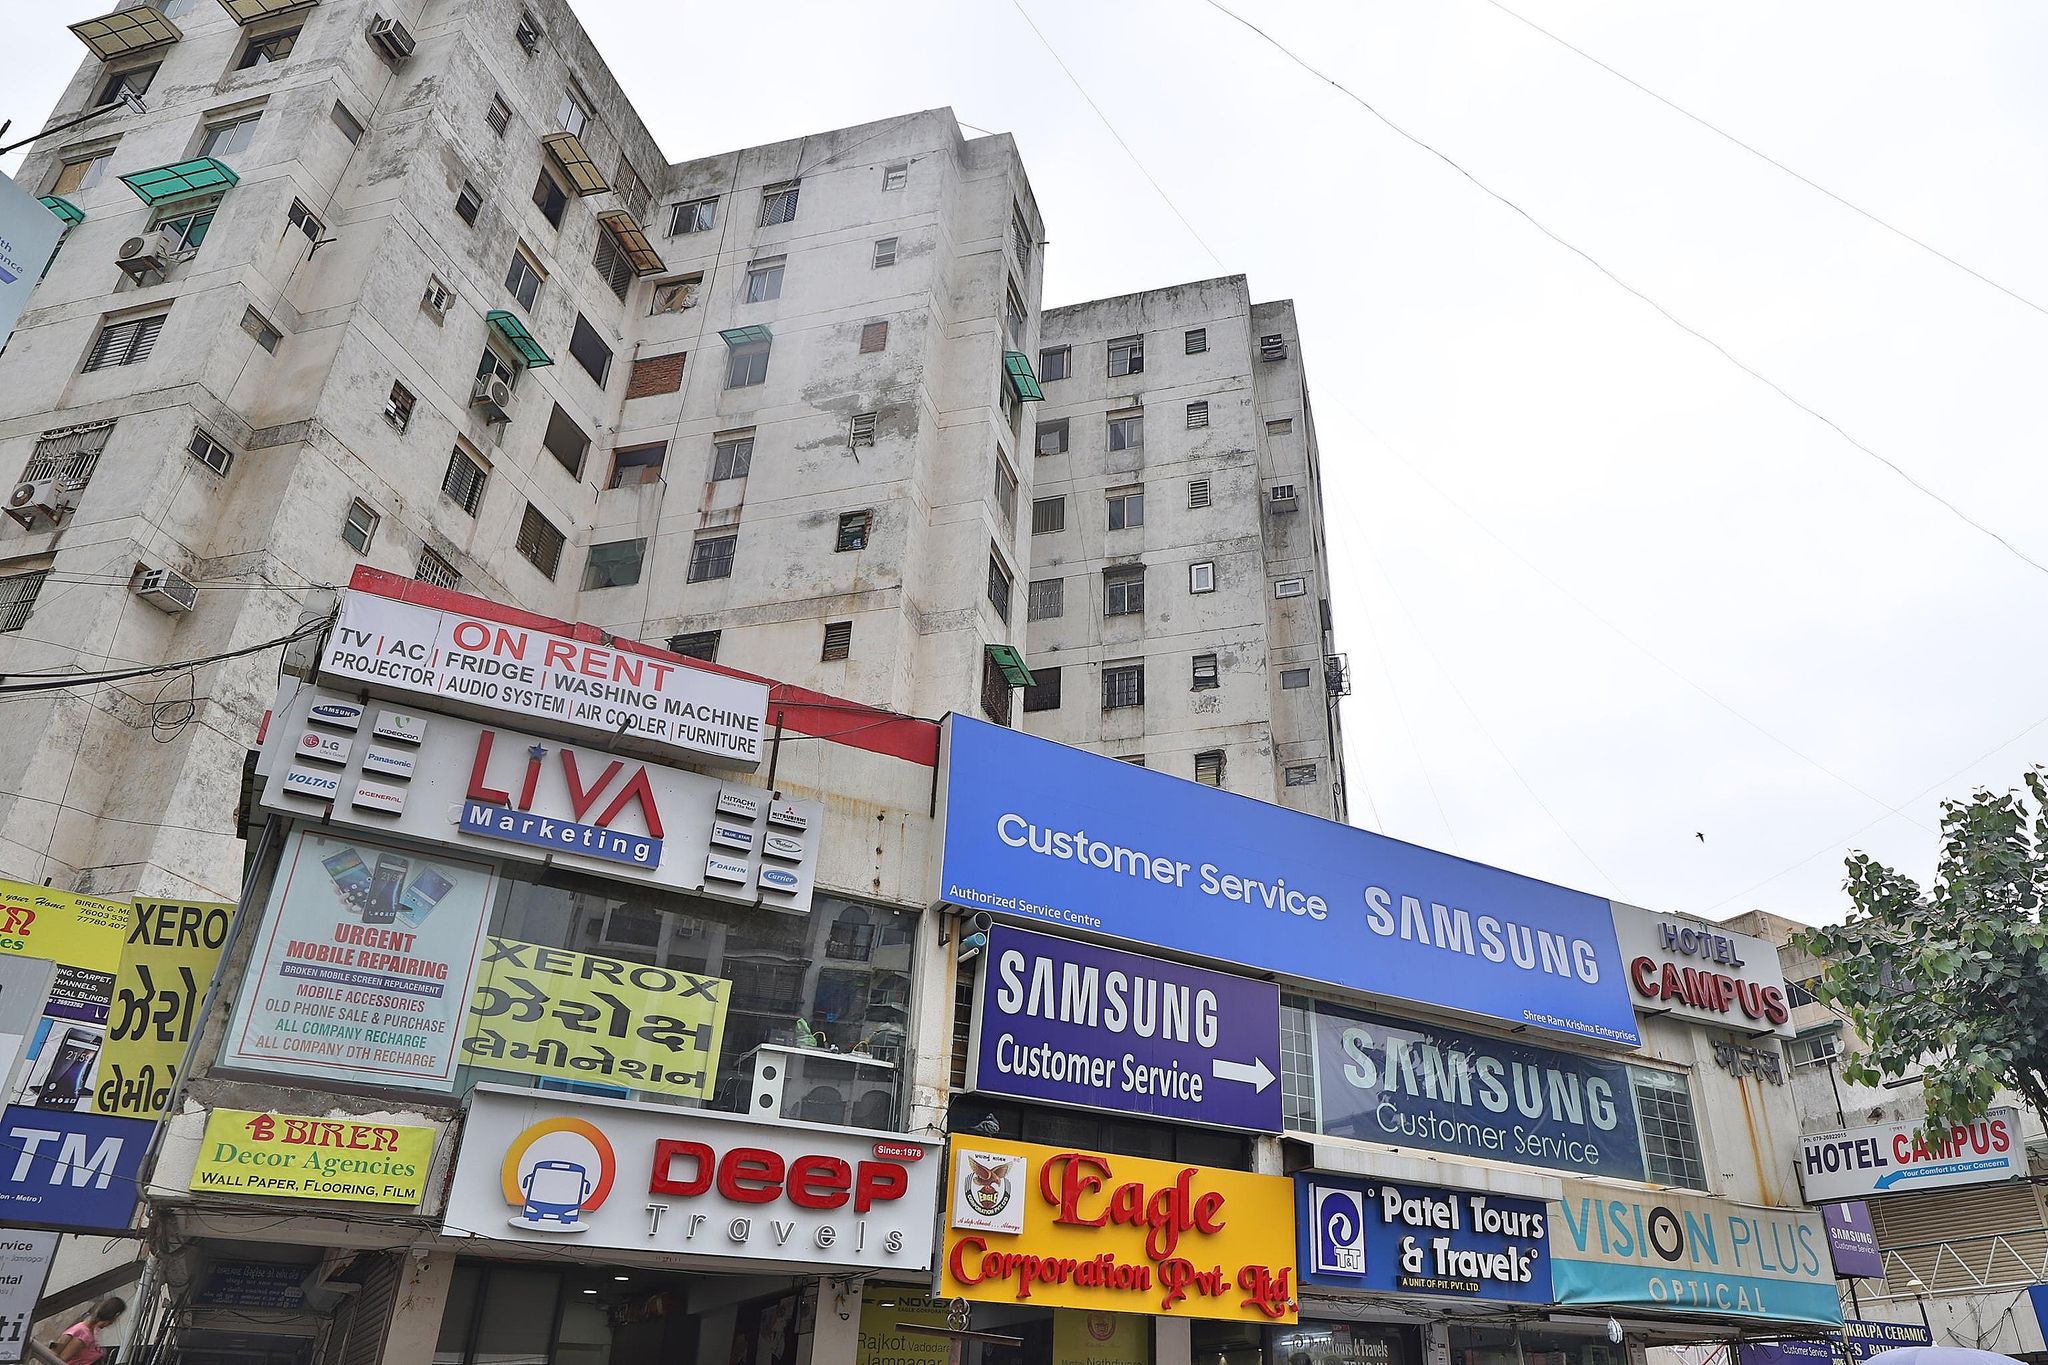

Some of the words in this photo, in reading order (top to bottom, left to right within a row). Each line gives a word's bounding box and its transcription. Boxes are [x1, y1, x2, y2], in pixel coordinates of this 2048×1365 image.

[452, 620, 531, 661] ON
[543, 638, 675, 692] RENT
[340, 626, 373, 648] TV
[387, 639, 426, 662] AC
[445, 651, 536, 685] FRIDGE
[554, 672, 659, 711] WASHING
[662, 698, 760, 734] MACHINE
[318, 704, 356, 717] SAMSUNG
[330, 650, 435, 688] PROJECTOR
[445, 677, 499, 701] AUDIO
[501, 687, 566, 715] SYSTEM
[575, 702, 602, 722] AIR
[604, 707, 667, 737] COOLER
[676, 722, 757, 756] FURNITURE
[321, 740, 340, 751] LG
[368, 753, 412, 768] Panasonic
[287, 772, 338, 790] VOLTAS
[723, 794, 756, 808] HITACHI
[469, 804, 651, 863] Marketing
[717, 863, 747, 874] DAIKIN
[767, 872, 793, 883] Carrier
[997, 813, 1191, 888] Customer
[1199, 863, 1328, 921] Service
[5, 893, 30, 904] your
[35, 896, 66, 911] Home
[74, 898, 105, 911] BIREN
[106, 904, 116, 913] G.
[80, 907, 109, 919] 76003
[949, 884, 1017, 909] Authorized
[1018, 899, 1062, 919] Service
[1063, 909, 1101, 928] Centre
[76, 915, 106, 927] 77780
[107, 921, 127, 931] 407
[127, 903, 235, 949] XERO
[334, 922, 417, 953] URGENT
[1363, 885, 1600, 985] SAMSUNG
[286, 940, 354, 967] MOBILE
[356, 950, 449, 980] REPAIRING
[1657, 922, 1745, 968] HOTEL
[284, 964, 319, 977] BROKEN
[319, 968, 350, 982] MOBILE
[351, 974, 383, 987] SCREEN
[384, 979, 440, 995] REPLACEMENT
[481, 938, 721, 1003] XEROX
[296, 983, 343, 1001] MOBILE
[345, 990, 426, 1013] ACCESSORIES
[997, 950, 1218, 1048] SAMSUNG
[1631, 956, 1789, 1025] CAMPUS
[265, 997, 290, 1013] OLD
[293, 1001, 335, 1019] PHONE
[338, 1007, 369, 1023] SALE
[371, 1012, 380, 1025] &
[383, 1014, 446, 1034] PURCHASE
[1523, 1009, 1547, 1025] Shree
[1547, 1014, 1565, 1028] Ram
[1565, 1017, 1595, 1034] Krishna
[1595, 1024, 1637, 1042] Enterprises
[275, 1018, 299, 1032] ALL
[302, 1021, 362, 1040] COMPANY
[364, 1030, 428, 1049] RECHARGE
[255, 1034, 279, 1049] ALL
[283, 1037, 343, 1056] COMPANY
[346, 1045, 370, 1059] DTH
[372, 1049, 437, 1068] RECHARGE
[996, 1033, 1116, 1089] Customer
[1122, 1053, 1203, 1102] Service
[1341, 1027, 1618, 1131] SAMSUNG
[281, 1119, 400, 1153] BIREN
[1376, 1102, 1507, 1151] Customer
[1514, 1126, 1600, 1165] Service
[212, 1142, 296, 1169] Decor
[301, 1150, 415, 1178] Agencies
[1805, 1138, 1888, 1175] HOTEL
[1902, 1170, 1918, 1178] Your
[1919, 1166, 1949, 1176] Comfort
[1957, 1163, 1972, 1172] Our
[1972, 1160, 2005, 1170] Concern
[15, 1194, 38, 1203] Metro
[201, 1171, 244, 1187] WALL
[246, 1174, 299, 1192] PAPER,
[303, 1178, 379, 1198] FLOORING,
[382, 1184, 416, 1199] FILM
[1039, 1153, 1227, 1261] Eagle
[1381, 1186, 1460, 1230] Patel
[1469, 1196, 1545, 1239] Tours
[645, 1203, 904, 1255] Travels
[1561, 1195, 1720, 1265] VISION
[1728, 1215, 1820, 1277] PLUS
[1830, 1227, 1873, 1244] SAMSUNG
[1402, 1236, 1424, 1273] &
[1432, 1237, 1532, 1283] Travels
[1834, 1240, 1857, 1251] Customer
[1857, 1244, 1875, 1255] Service
[949, 1236, 1152, 1299] Corporation
[1402, 1278, 1408, 1286] A
[1426, 1279, 1437, 1288] OF
[1450, 1281, 1465, 1290] PVT.
[1466, 1282, 1481, 1292] LTD.
[1648, 1276, 1767, 1313] OPTICAL
[858, 1332, 906, 1354] Rajkot
[1360, 1339, 1388, 1358] Travels
[1782, 1344, 1809, 1356] Customer
[1808, 1346, 1828, 1358] Service
[1885, 1326, 1928, 1342] CERAMIC
